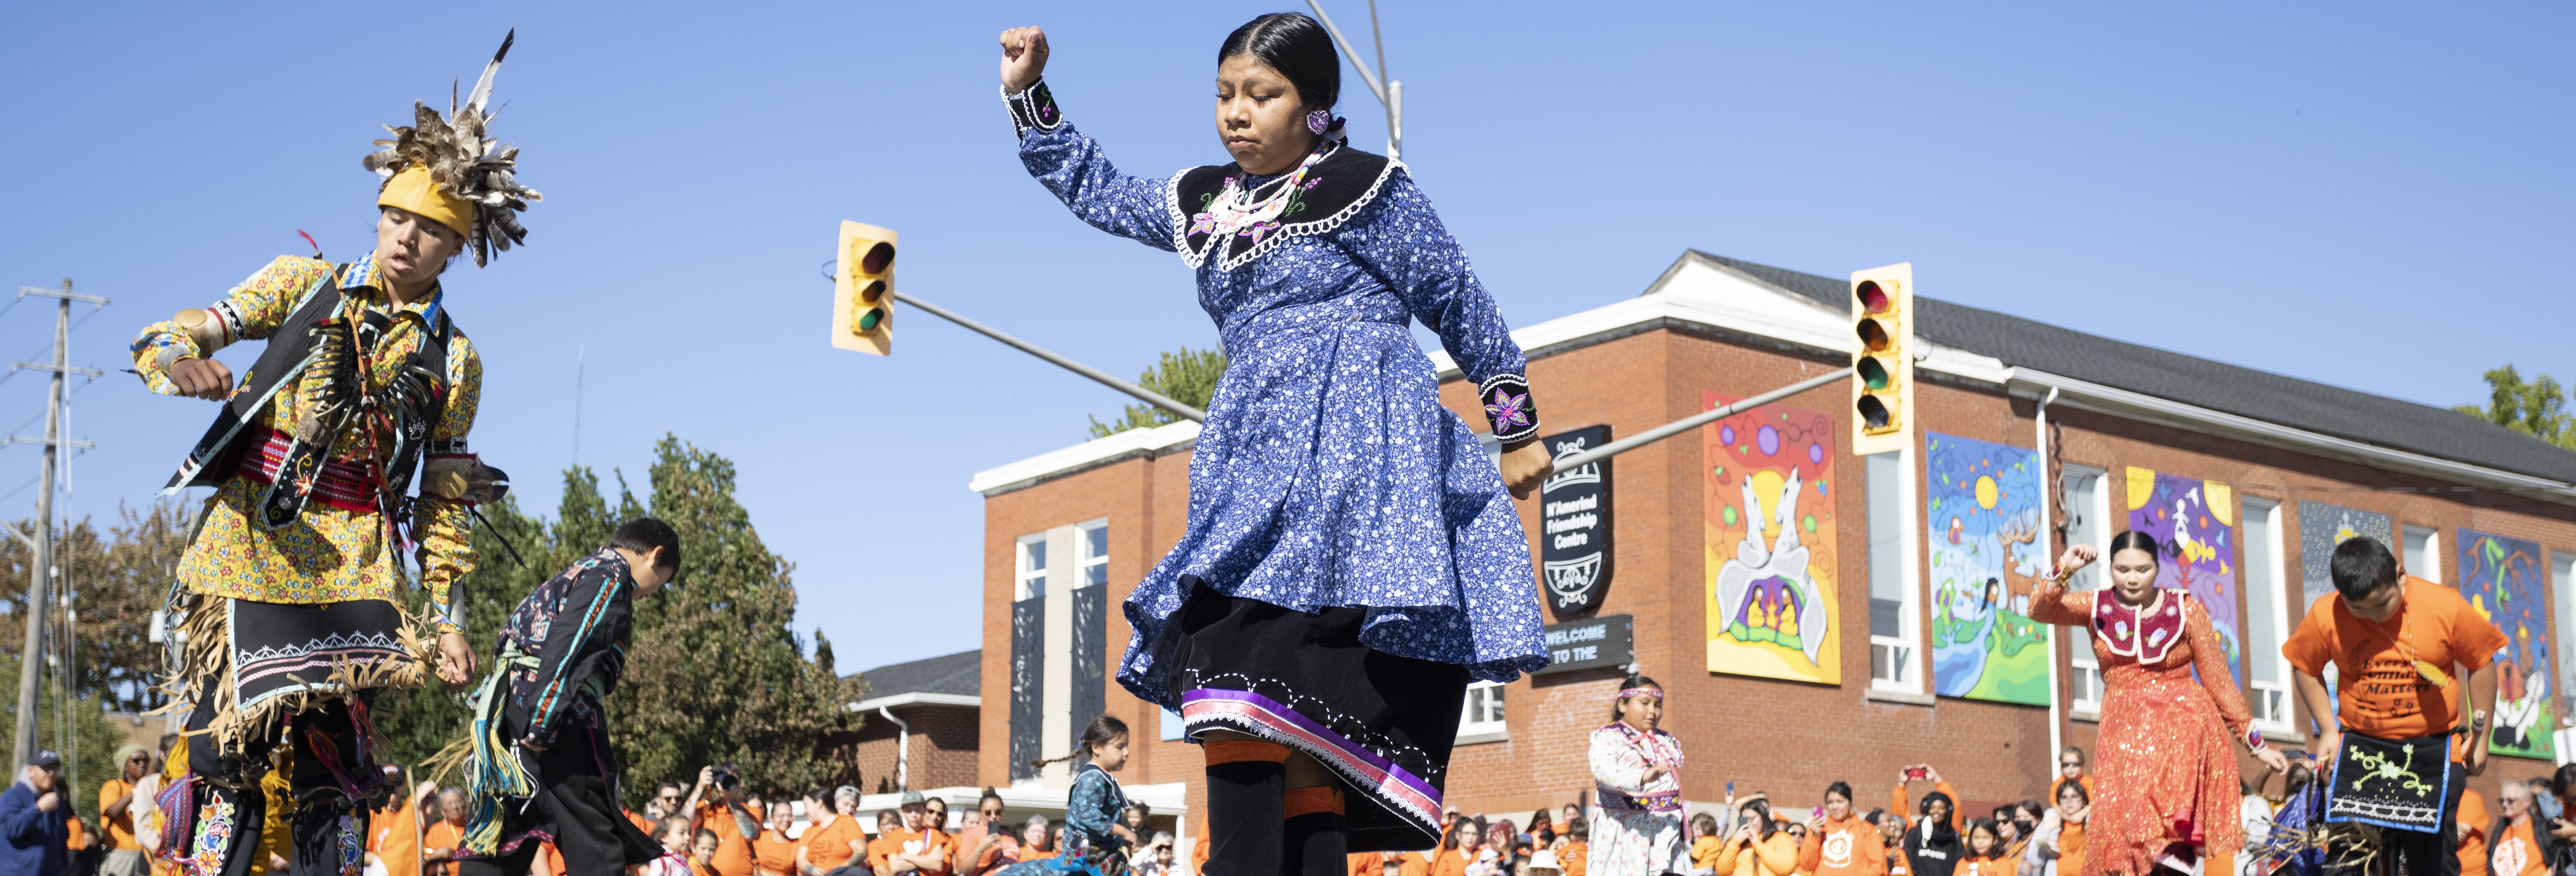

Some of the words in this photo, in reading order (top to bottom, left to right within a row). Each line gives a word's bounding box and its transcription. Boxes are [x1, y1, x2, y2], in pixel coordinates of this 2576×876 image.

[1546, 493, 1597, 518] N'Amerind
[1547, 512, 1597, 535] Friendship
[1555, 532, 1588, 550] Centre
[1546, 624, 1606, 646] WELCOME
[1552, 649, 1570, 664] TO
[1572, 645, 1597, 661] THE
[2366, 683, 2430, 694] Matters
